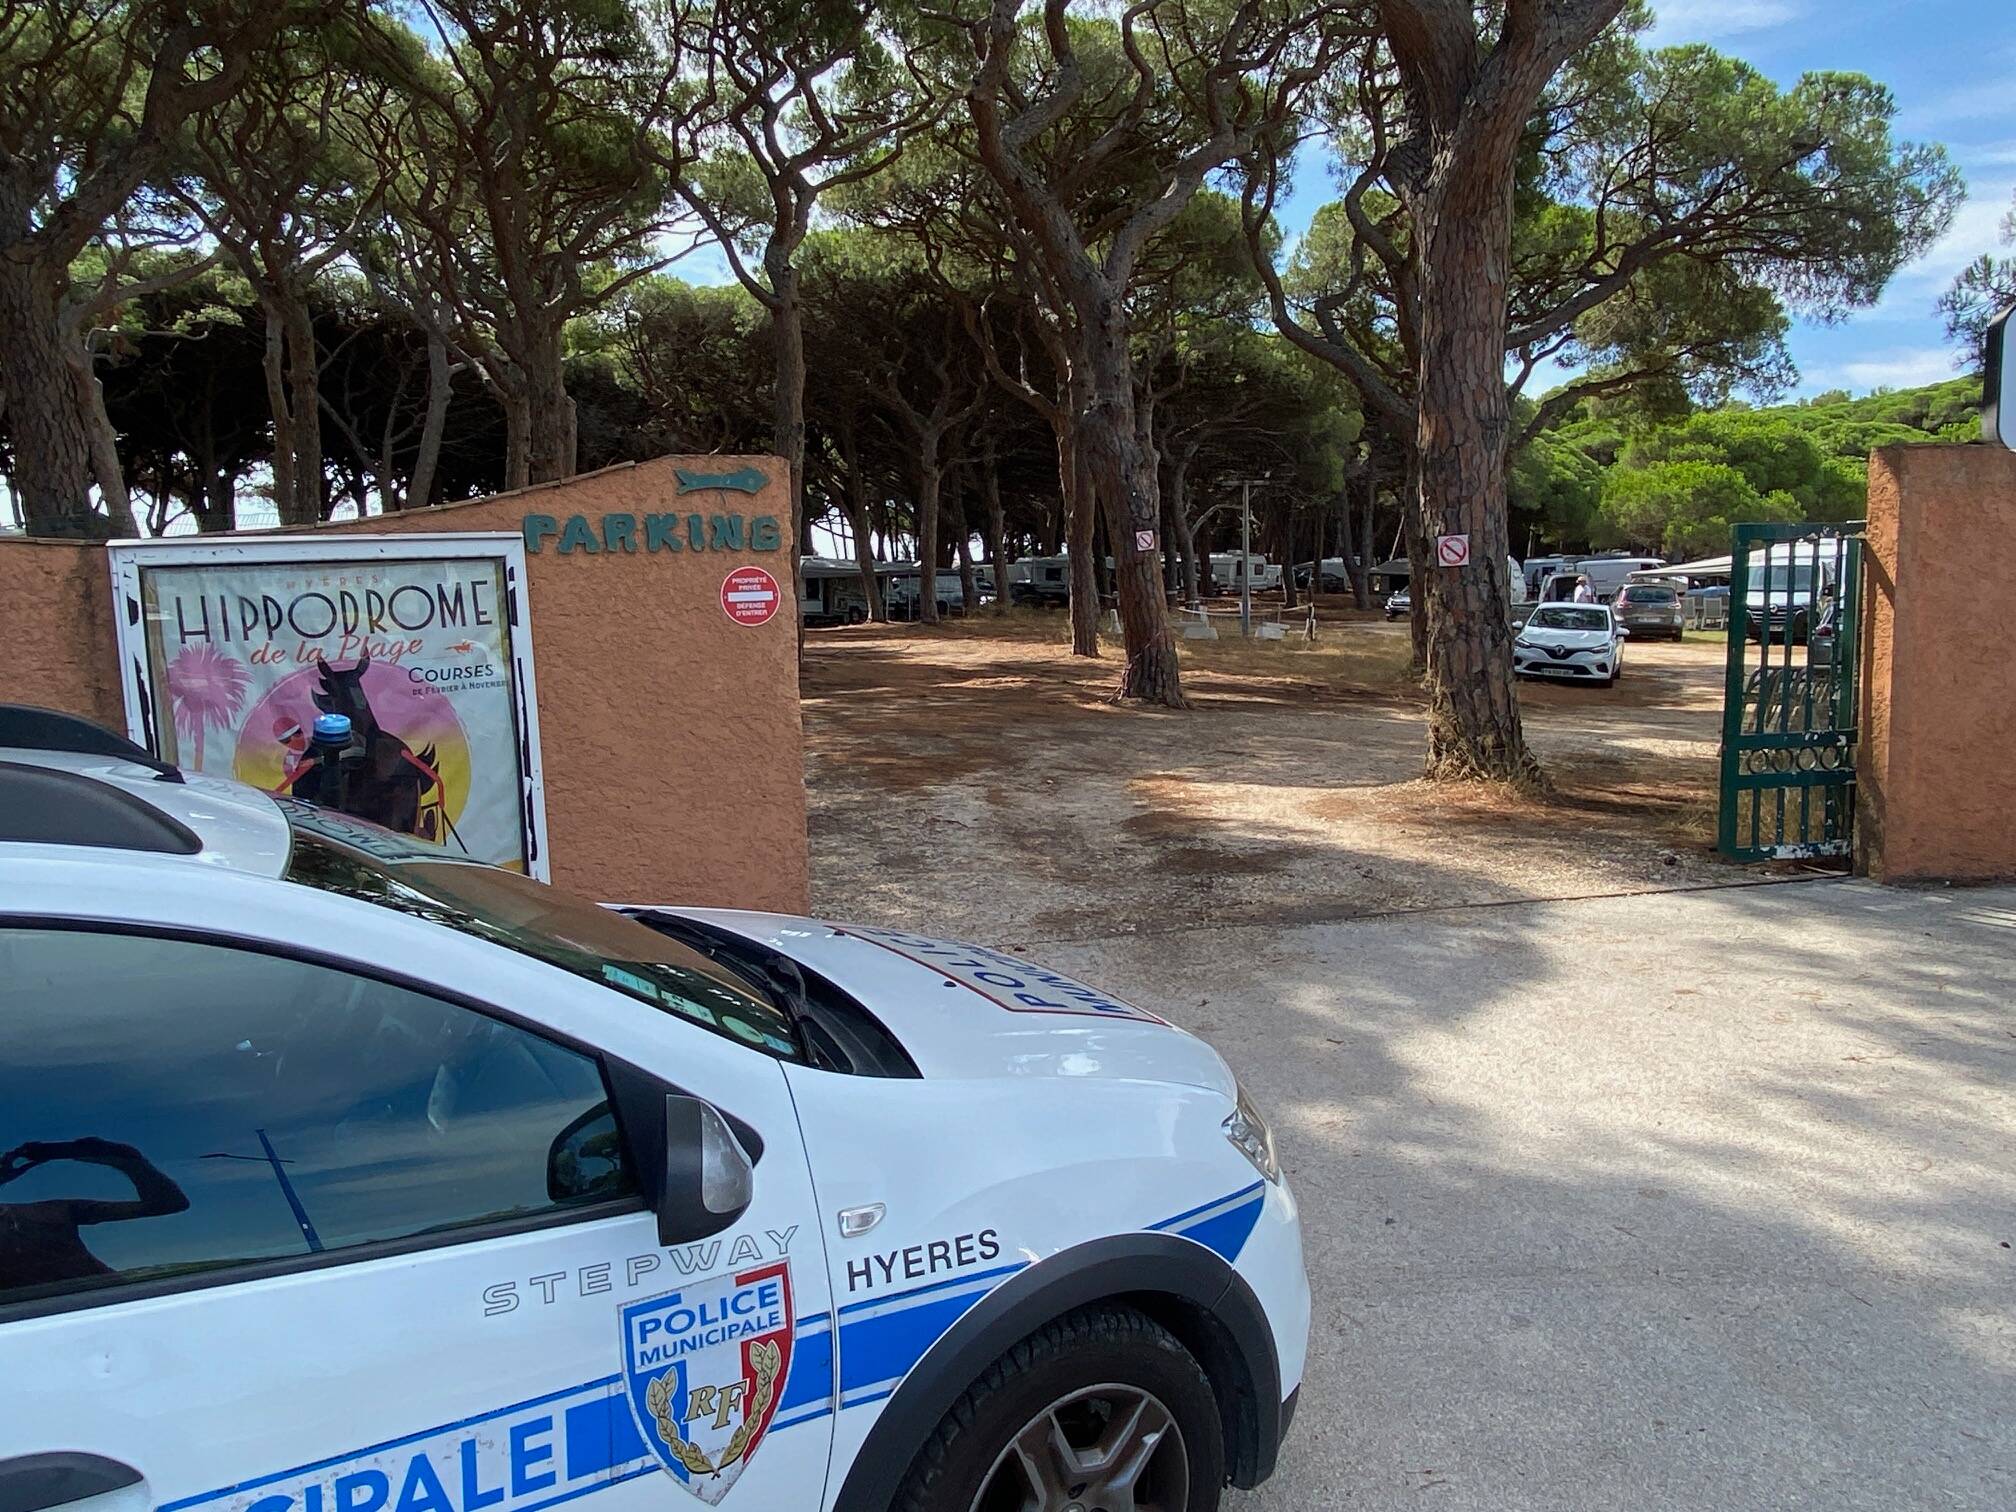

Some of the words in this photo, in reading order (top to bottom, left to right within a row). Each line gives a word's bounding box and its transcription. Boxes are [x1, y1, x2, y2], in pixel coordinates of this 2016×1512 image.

[523, 512, 782, 554] PARKING
[175, 580, 493, 644] HIPPODROME
[250, 642, 286, 666] de
[295, 640, 329, 664] la
[331, 633, 424, 666] Plage
[408, 664, 494, 684] COURSES
[862, 929, 1069, 1009] POLICE
[483, 1224, 800, 1318] STEPWAY
[846, 1229, 1000, 1293] HYERES
[638, 1282, 781, 1345] POLICE
[638, 1310, 782, 1367] MUNICIPALE
[682, 1378, 750, 1431] RF
[246, 1415, 558, 1512] PALE
